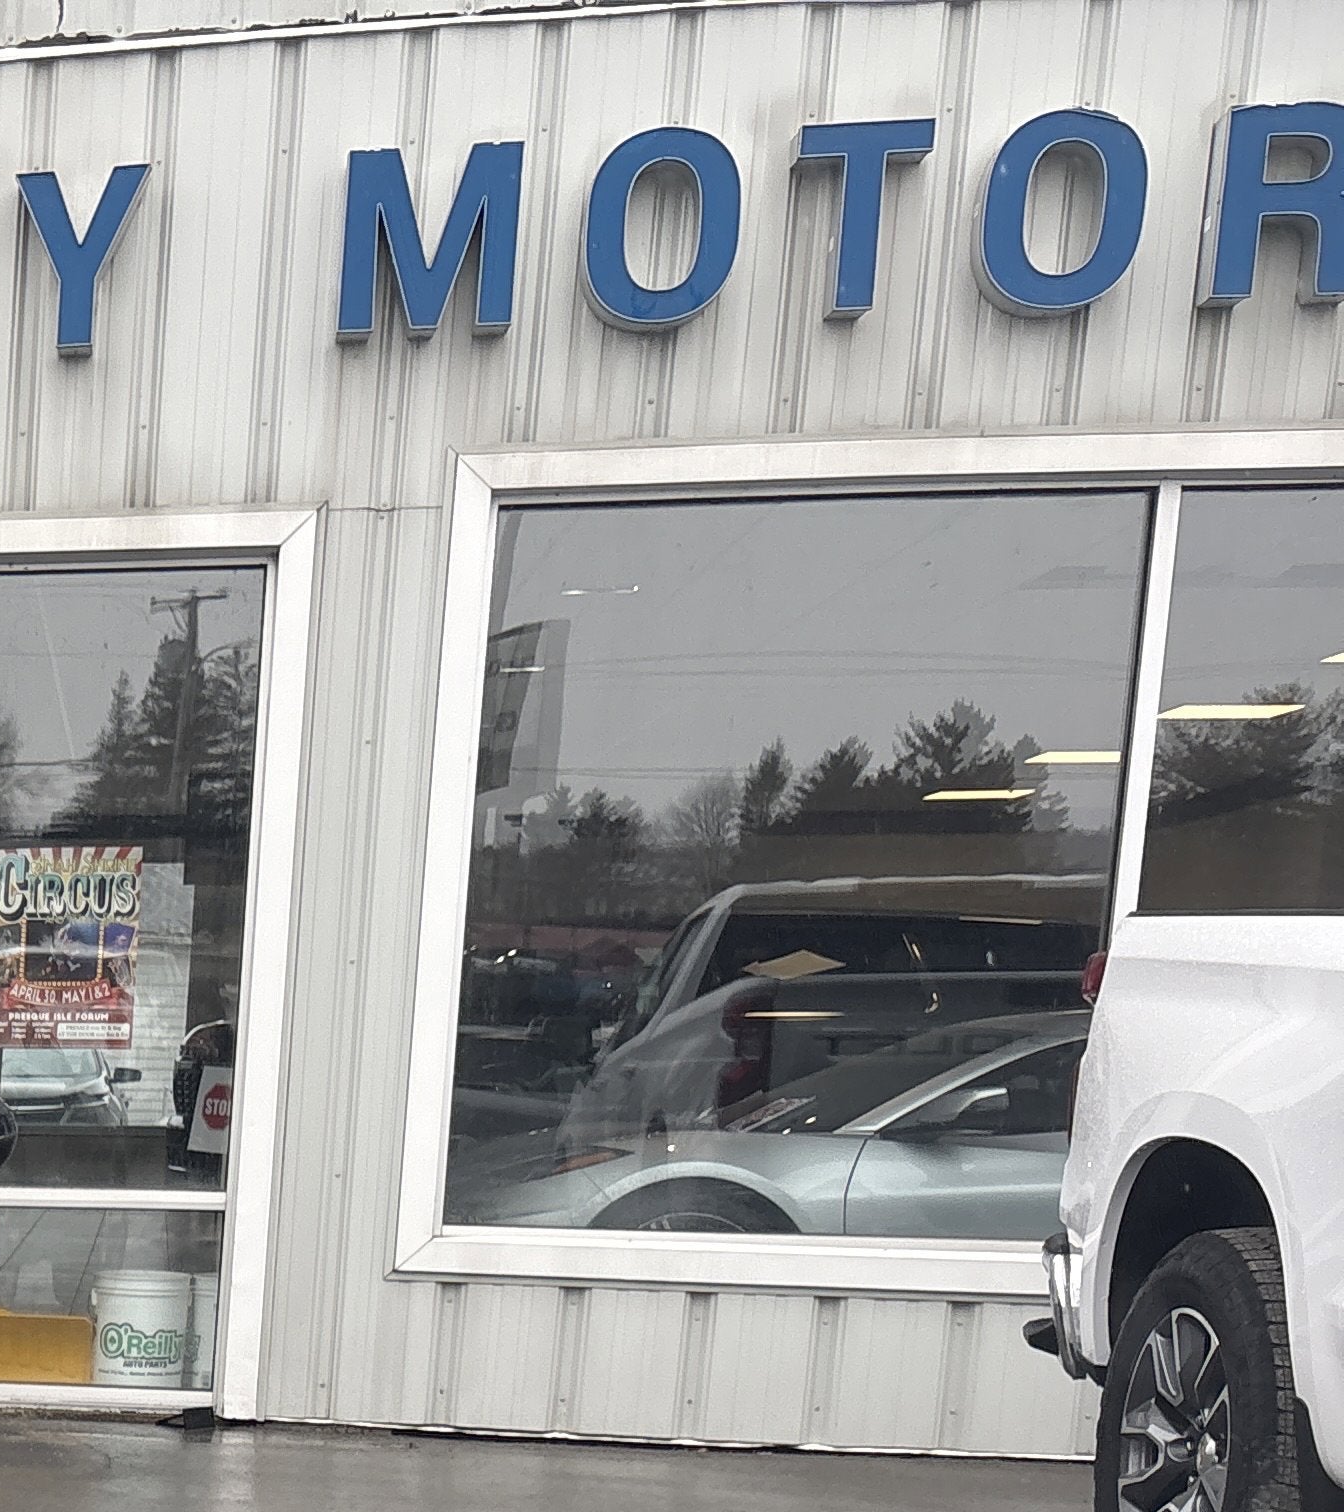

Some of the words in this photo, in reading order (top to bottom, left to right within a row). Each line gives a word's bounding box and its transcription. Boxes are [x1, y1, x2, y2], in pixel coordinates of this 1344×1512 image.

[335, 101, 1344, 343] MOTOR
[10, 983, 41, 1003] APRIL
[62, 988, 87, 1003] MAY
[103, 983, 111, 997] 2
[8, 1012, 49, 1021] PRESQUE
[53, 1012, 72, 1021] ISLE
[75, 1012, 109, 1021] FORUM
[100, 1323, 182, 1364] O'Reilly
